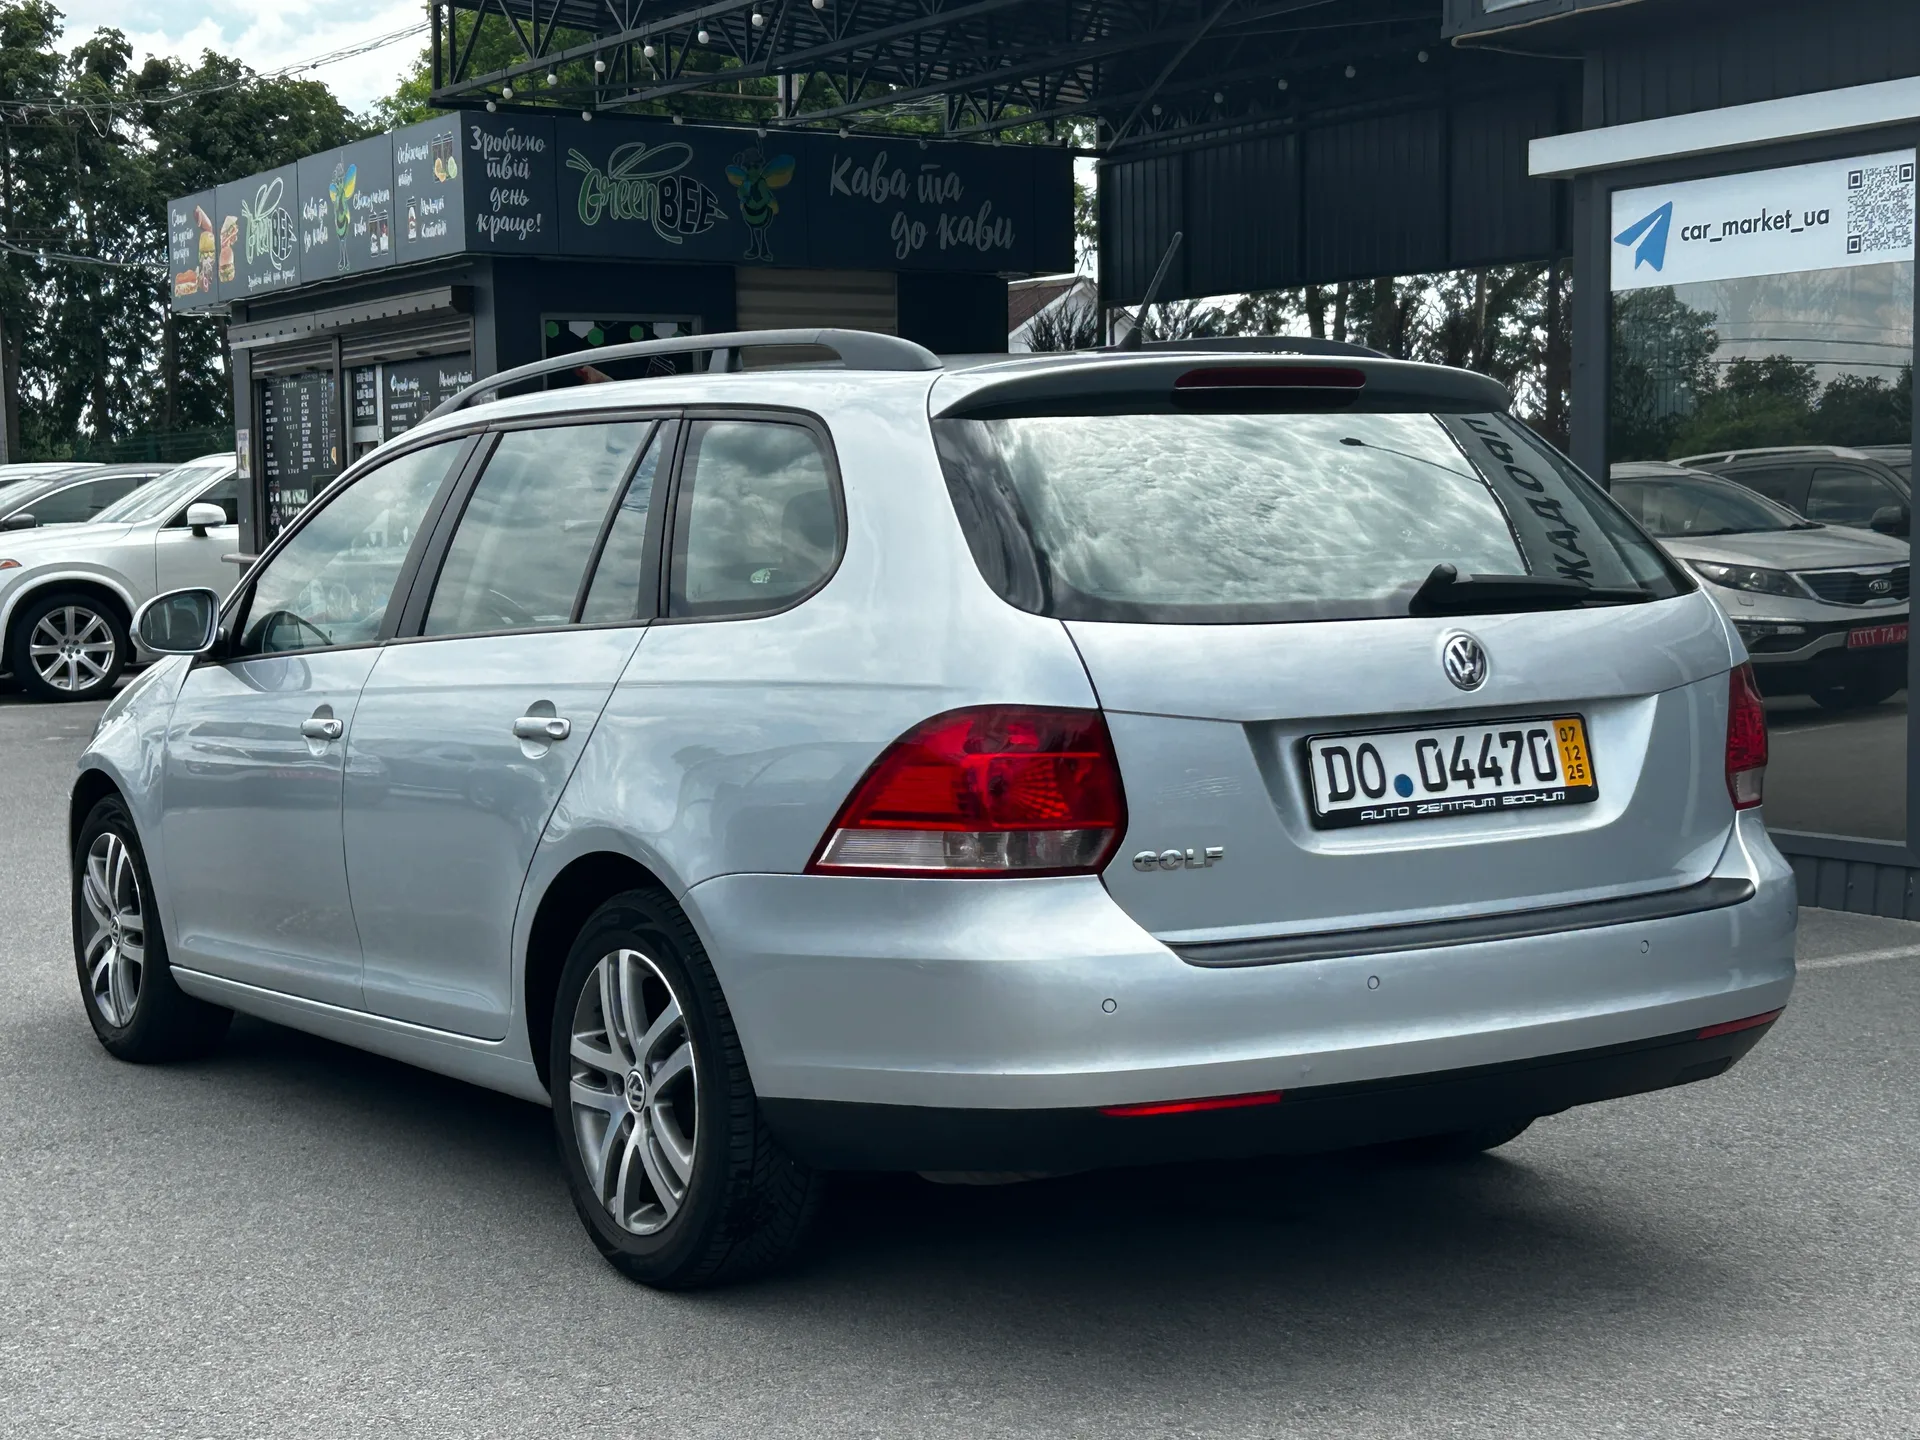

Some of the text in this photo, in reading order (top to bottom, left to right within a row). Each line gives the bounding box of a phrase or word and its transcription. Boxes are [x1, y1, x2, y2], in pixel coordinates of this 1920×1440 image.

[470, 125, 546, 160] Зробимо
[486, 157, 531, 180] твій
[830, 150, 964, 204] Кава та
[490, 185, 530, 212] день
[476, 213, 542, 242] краще!
[891, 200, 1015, 260] до кави
[1680, 208, 1830, 243] car_market_ua
[1559, 726, 1576, 743] 07
[1320, 728, 1558, 803] DO 04470
[1564, 745, 1581, 761] 12
[1567, 763, 1584, 781] 25
[1360, 790, 1566, 821] AUTO ZENTRUM BOCHUM
[1132, 846, 1224, 873] GOLF
